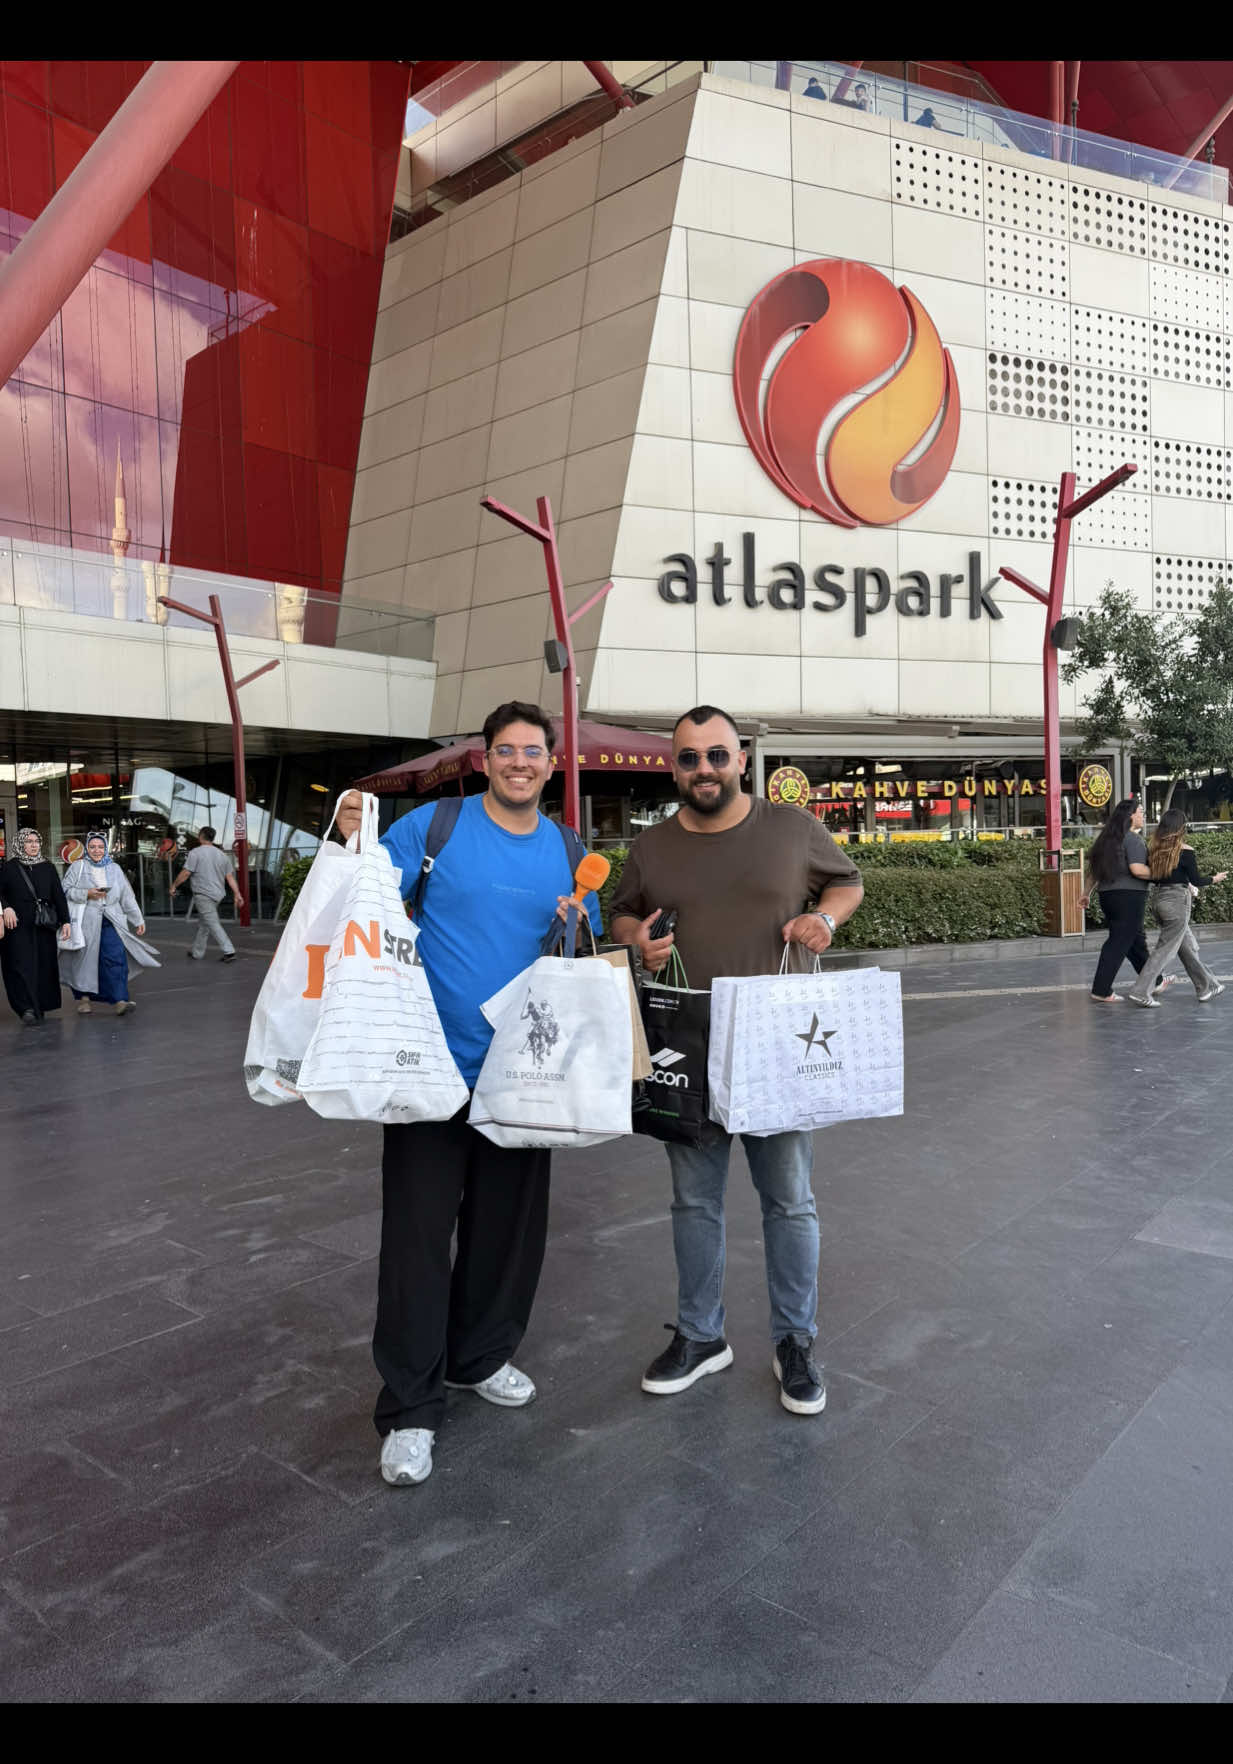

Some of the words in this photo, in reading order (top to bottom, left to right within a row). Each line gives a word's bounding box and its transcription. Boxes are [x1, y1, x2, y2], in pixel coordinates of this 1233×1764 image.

[658, 531, 1003, 637] atlaspark
[600, 753, 665, 766] DÜNYA
[831, 780, 928, 798] KAHVE
[943, 777, 1047, 797] DÜNYAS
